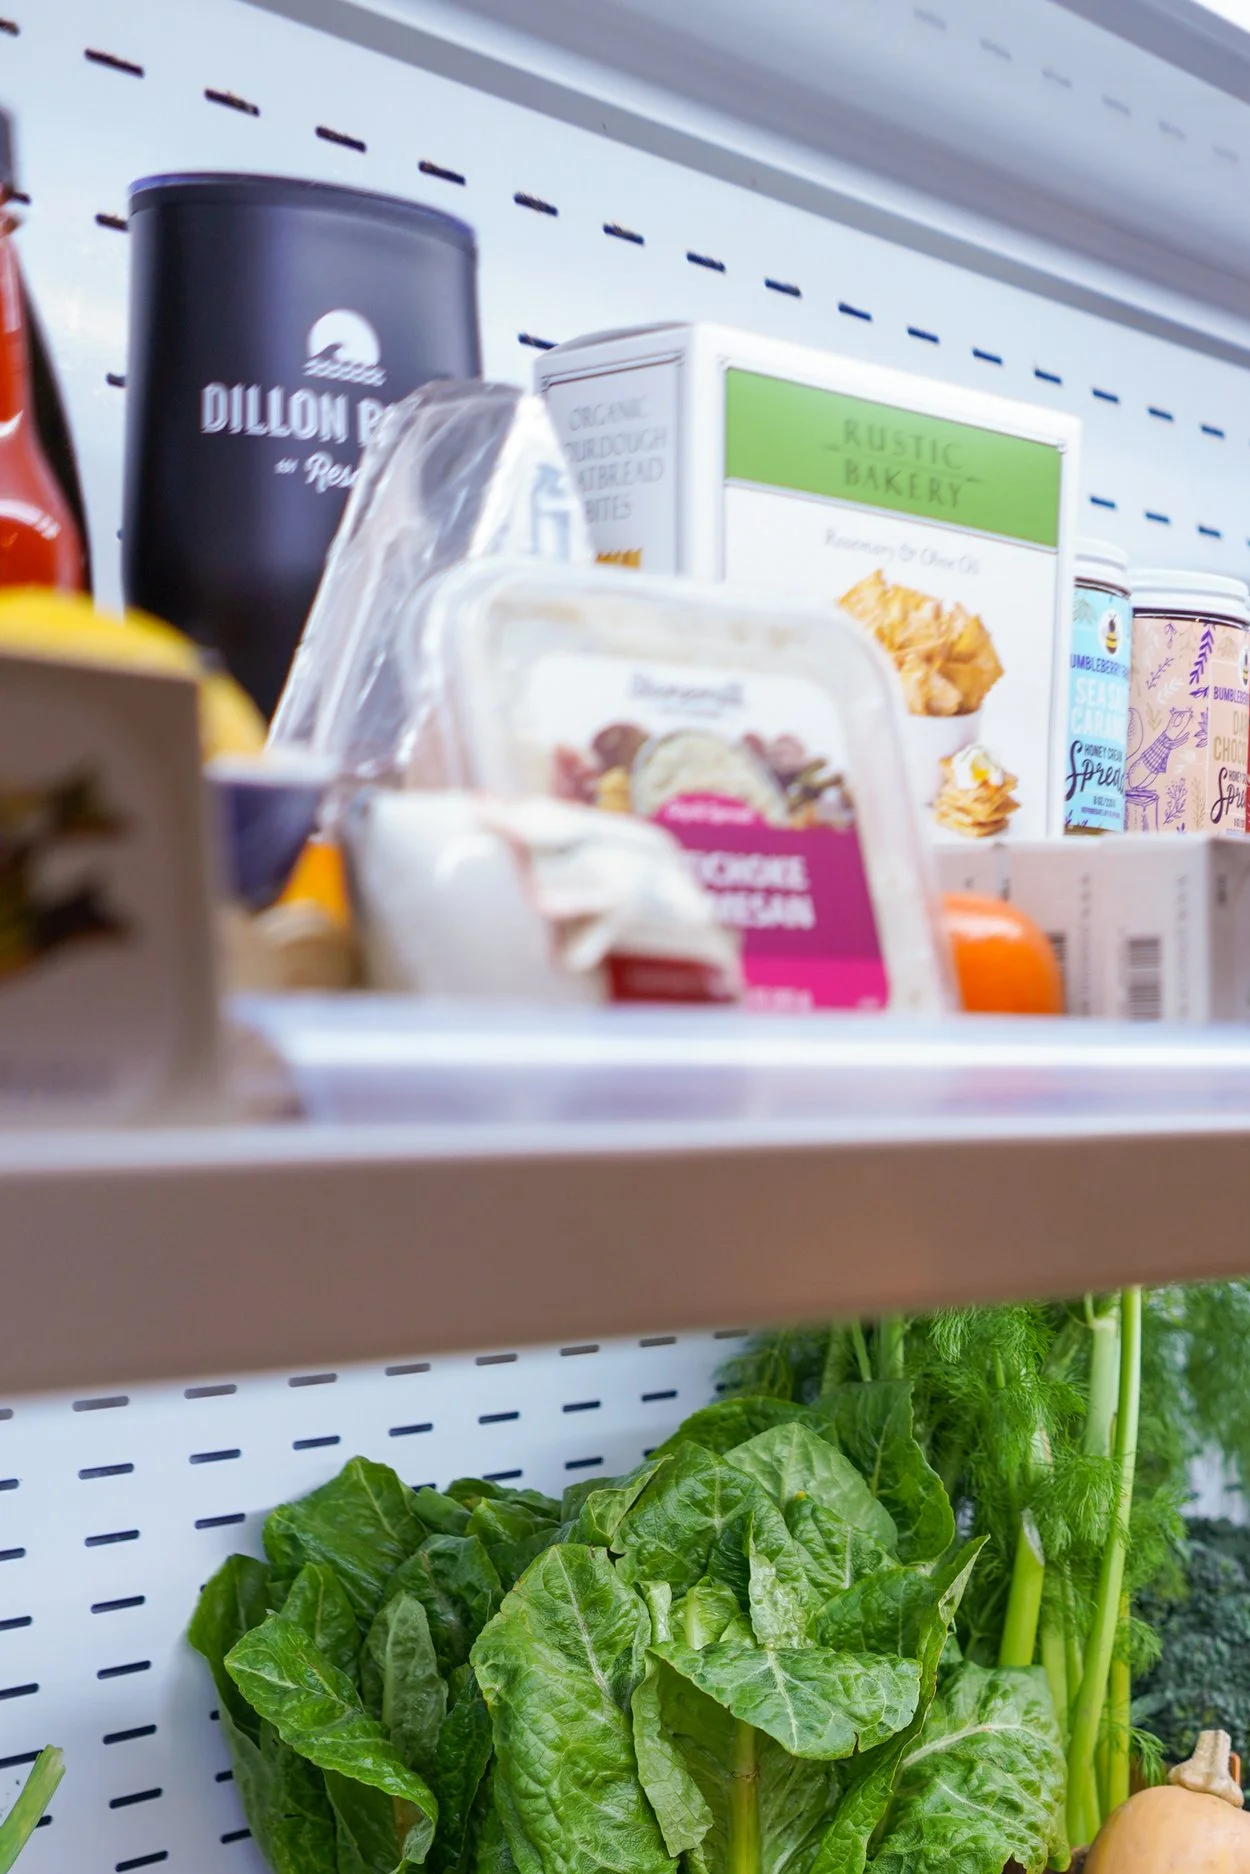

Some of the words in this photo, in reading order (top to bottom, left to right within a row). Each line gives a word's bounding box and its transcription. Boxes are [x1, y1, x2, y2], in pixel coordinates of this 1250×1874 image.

[200, 382, 349, 445] DILLON
[569, 395, 648, 431] ORGANIC
[564, 426, 668, 462] OURDOUGH
[843, 418, 964, 470] RUSTIC
[843, 458, 964, 508] BAKERY
[1070, 653, 1121, 677] UMBLEBERRY
